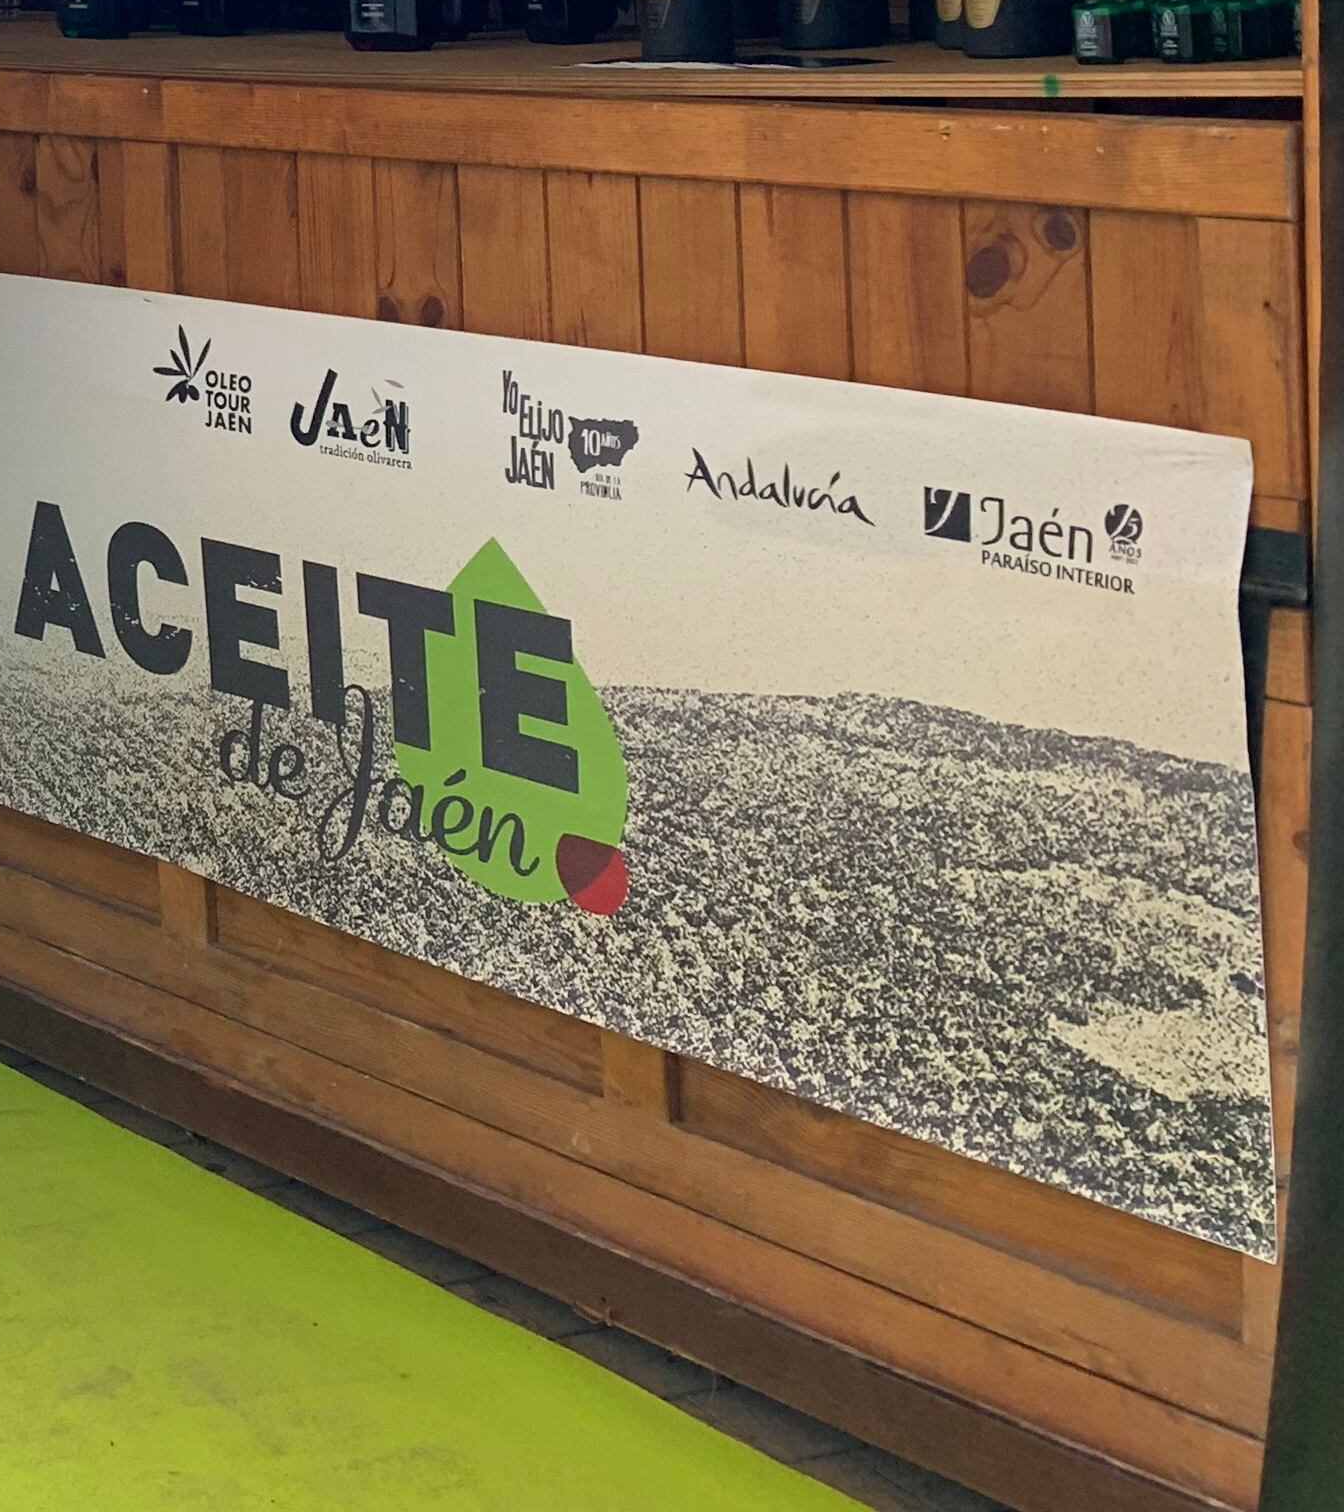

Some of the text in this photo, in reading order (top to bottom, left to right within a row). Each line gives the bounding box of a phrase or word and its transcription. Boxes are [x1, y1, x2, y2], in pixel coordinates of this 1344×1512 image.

[205, 370, 252, 394] OLEO
[205, 389, 251, 414] TOUR
[204, 409, 252, 435] JAEN
[580, 428, 622, 457] 10 AÑOS
[319, 444, 413, 470] tradición olivarera
[504, 435, 555, 491] JAÉN
[580, 480, 622, 501] PROVINCIA
[684, 446, 877, 528] Andalucía
[980, 496, 1094, 564] Jaén
[981, 550, 1136, 595] PARAÍSO INTERIOR
[14, 500, 580, 795] ACEITE
[219, 700, 309, 799] de
[320, 684, 540, 878] Jaén
